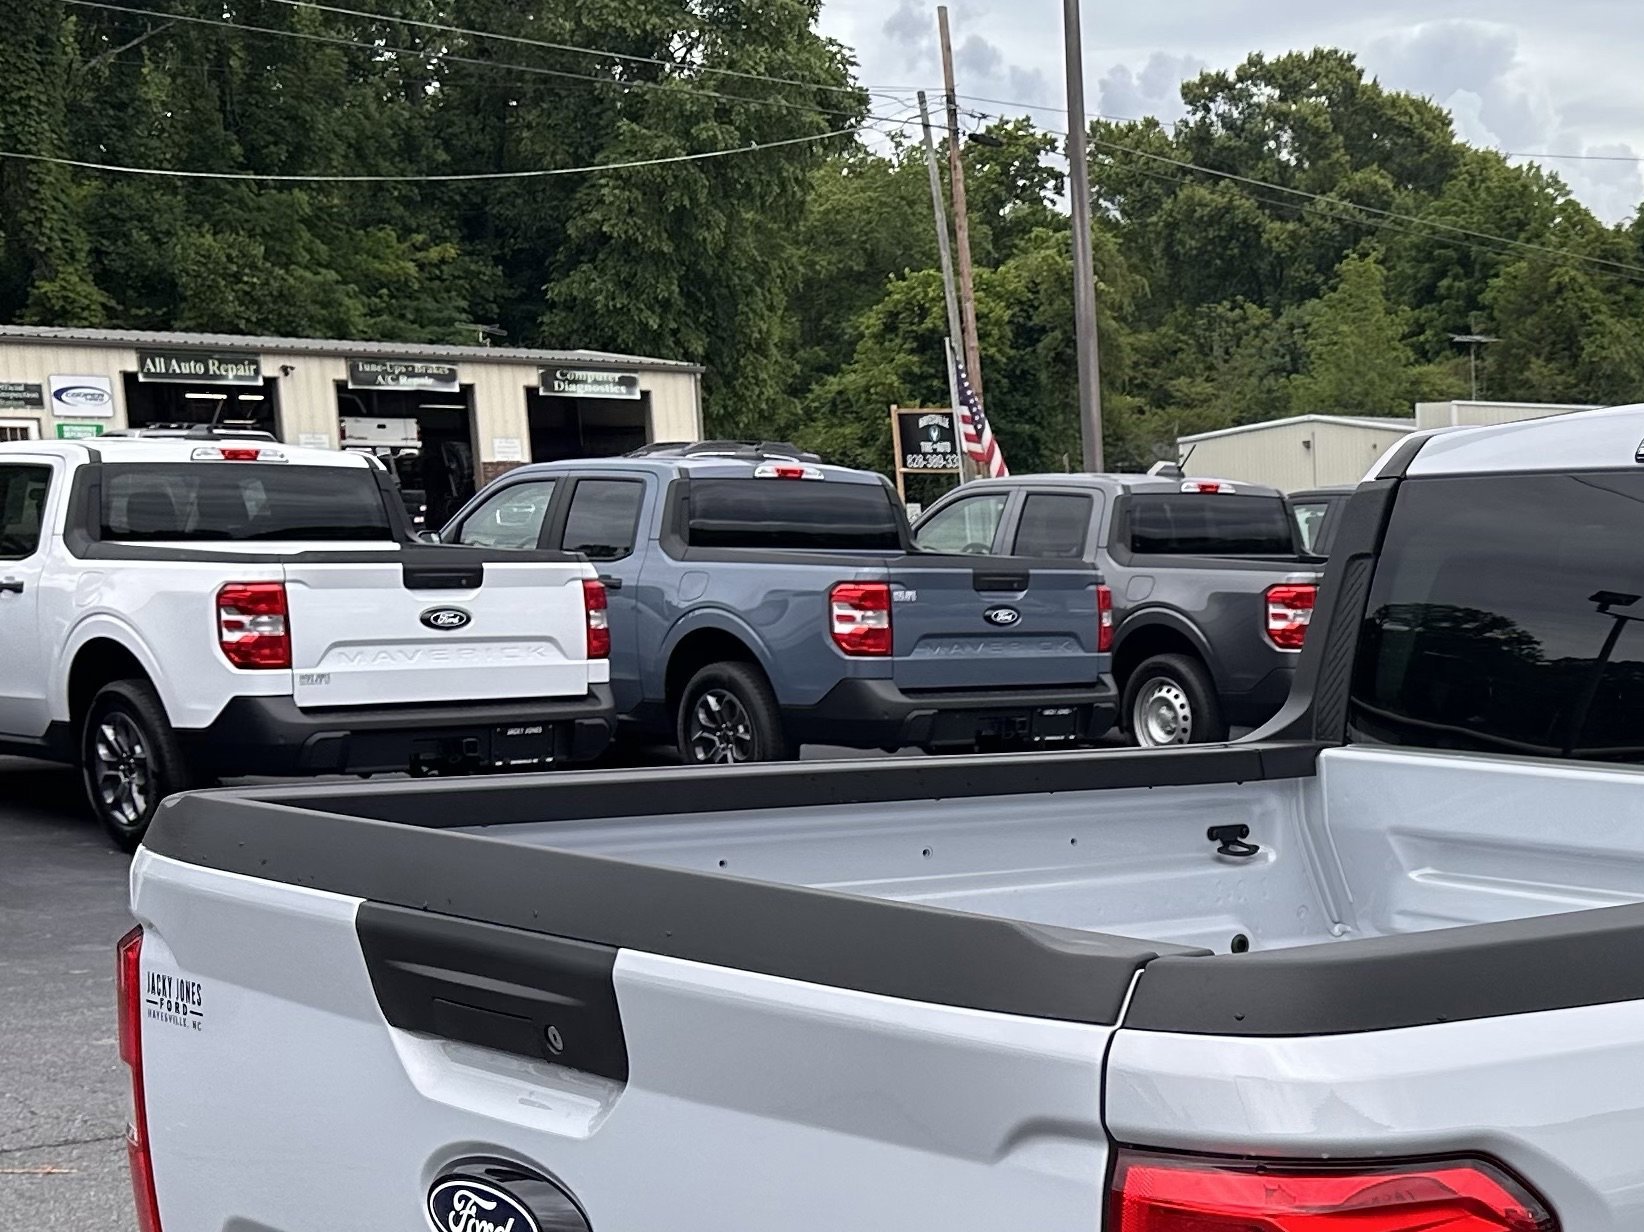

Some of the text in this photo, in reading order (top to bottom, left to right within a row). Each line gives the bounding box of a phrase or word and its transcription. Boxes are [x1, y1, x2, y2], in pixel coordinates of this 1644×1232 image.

[143, 357, 258, 379] All Auto Repair
[556, 369, 619, 383] Computer
[553, 380, 627, 395] Diagnostics
[926, 639, 1074, 656] MAVERCK
[338, 646, 548, 667] MAVERICK
[147, 971, 202, 1006] JACKY JONES
[160, 998, 188, 1015] FORD
[192, 1020, 202, 1031] NC
